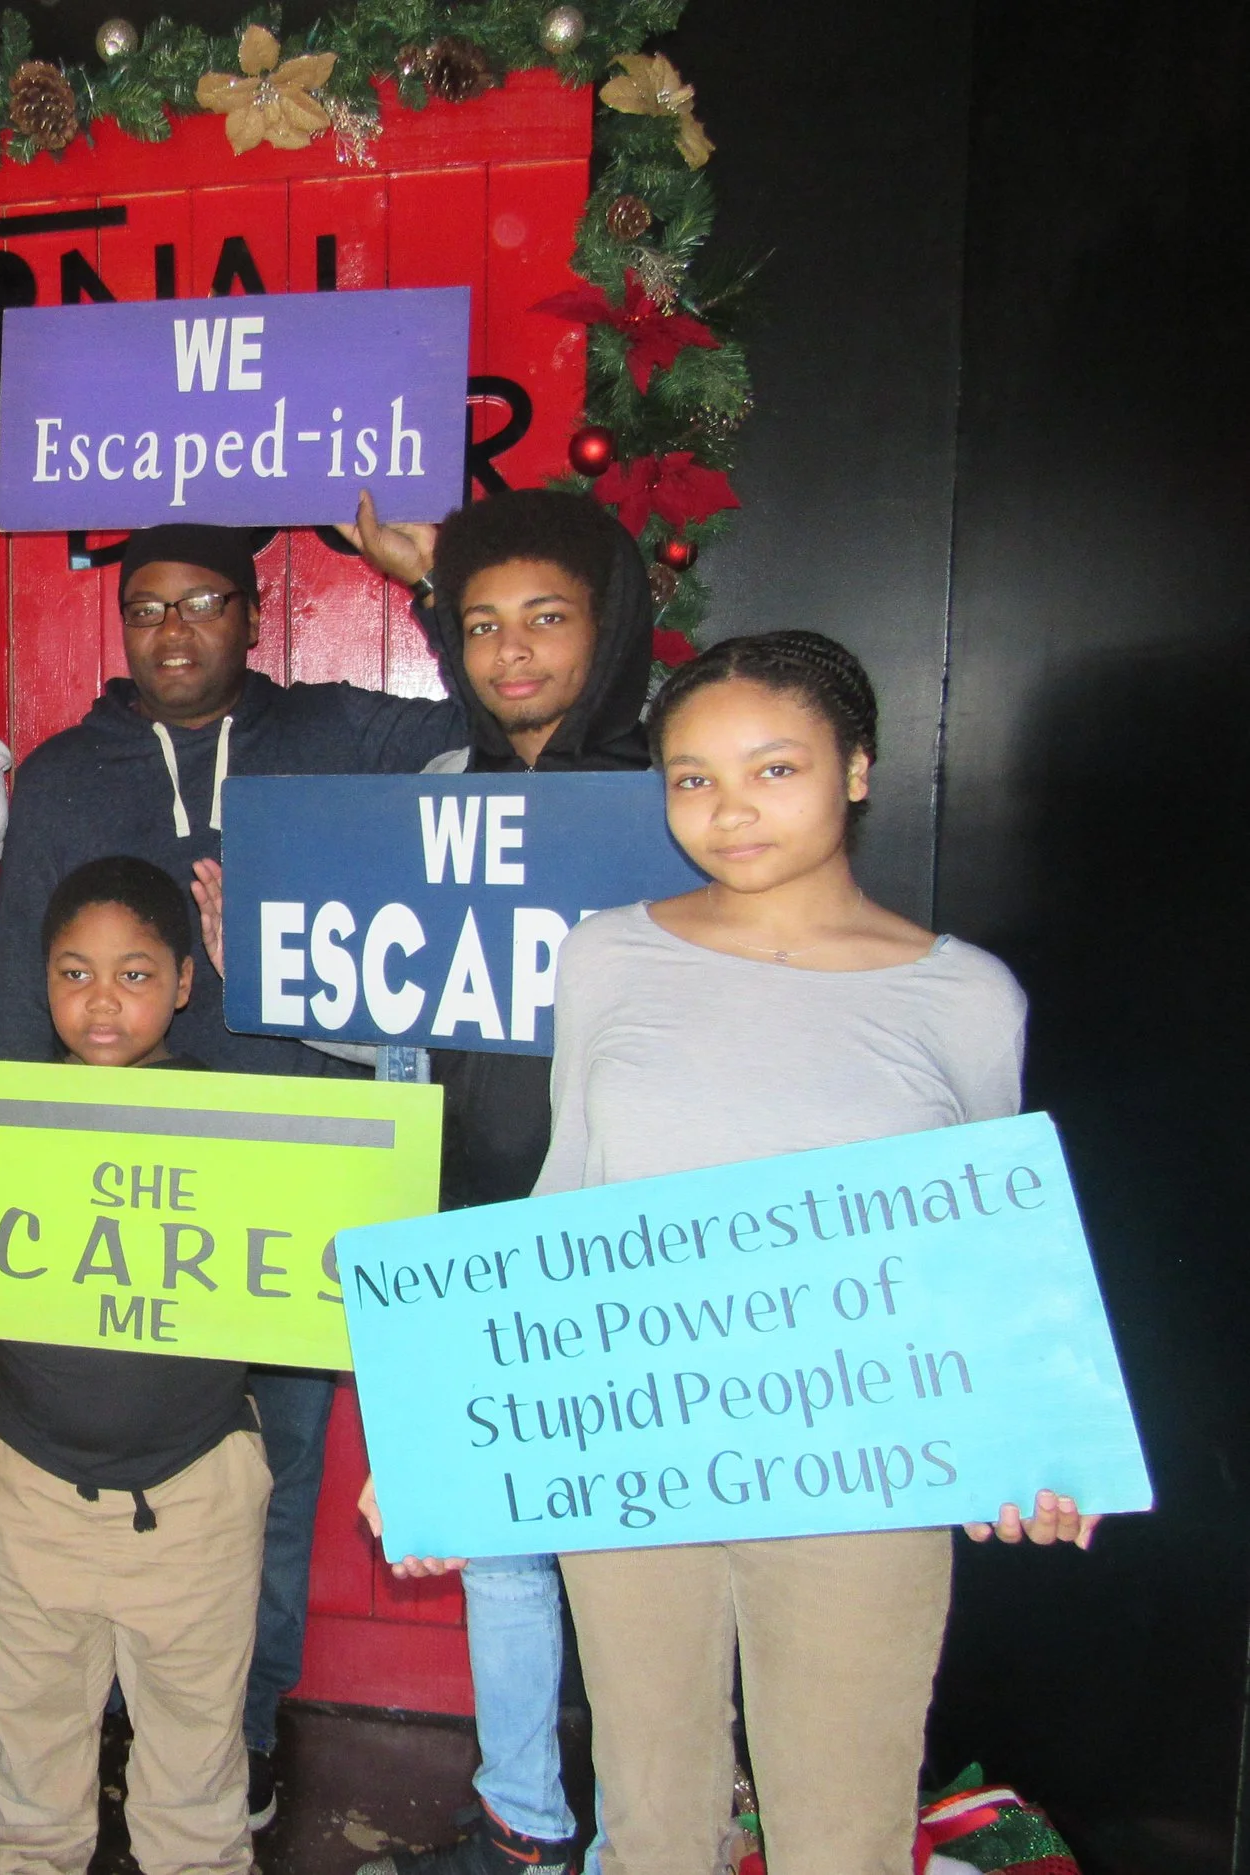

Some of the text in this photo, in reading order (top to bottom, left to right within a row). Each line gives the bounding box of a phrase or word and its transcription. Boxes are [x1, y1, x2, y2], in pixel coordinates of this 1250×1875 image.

[173, 317, 264, 392] WE
[32, 396, 426, 507] Escaped-ish
[419, 796, 526, 885] WE
[260, 900, 600, 1042] ESCAP
[90, 1161, 198, 1211] SHE
[353, 1160, 1048, 1310] Never Underestimate
[98, 1294, 178, 1342] ME
[483, 1256, 904, 1367] the Power of
[466, 1344, 974, 1452] Stupid People in
[504, 1436, 958, 1528] Large Groups
